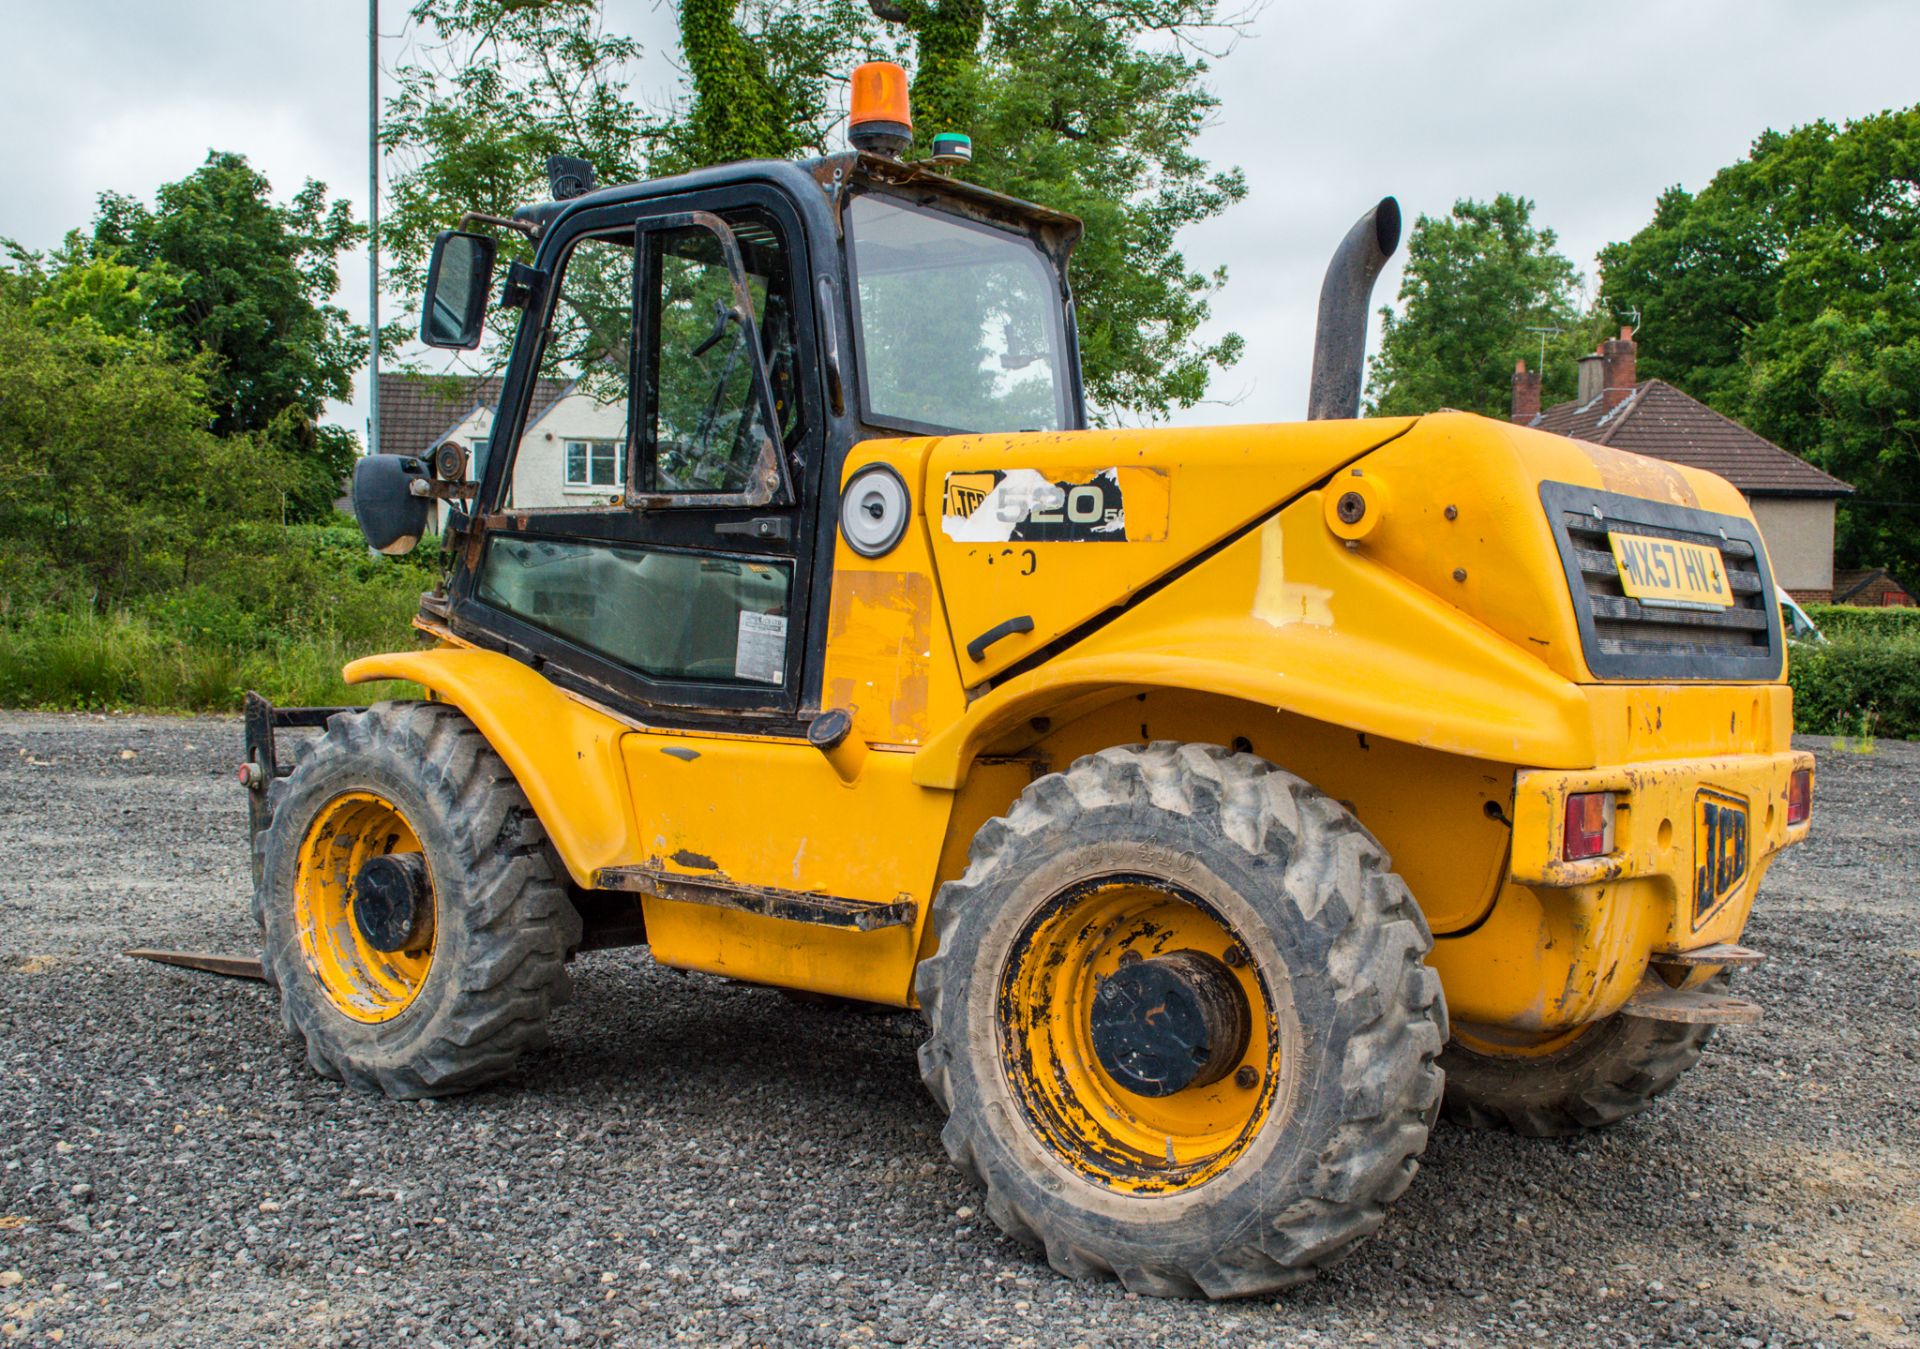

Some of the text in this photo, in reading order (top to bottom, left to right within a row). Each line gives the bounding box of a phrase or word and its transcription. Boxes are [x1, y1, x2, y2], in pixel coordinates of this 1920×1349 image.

[996, 485, 1104, 523] 520
[1620, 539, 1723, 594] MX57 HVJ
[1697, 802, 1746, 919] JCB
